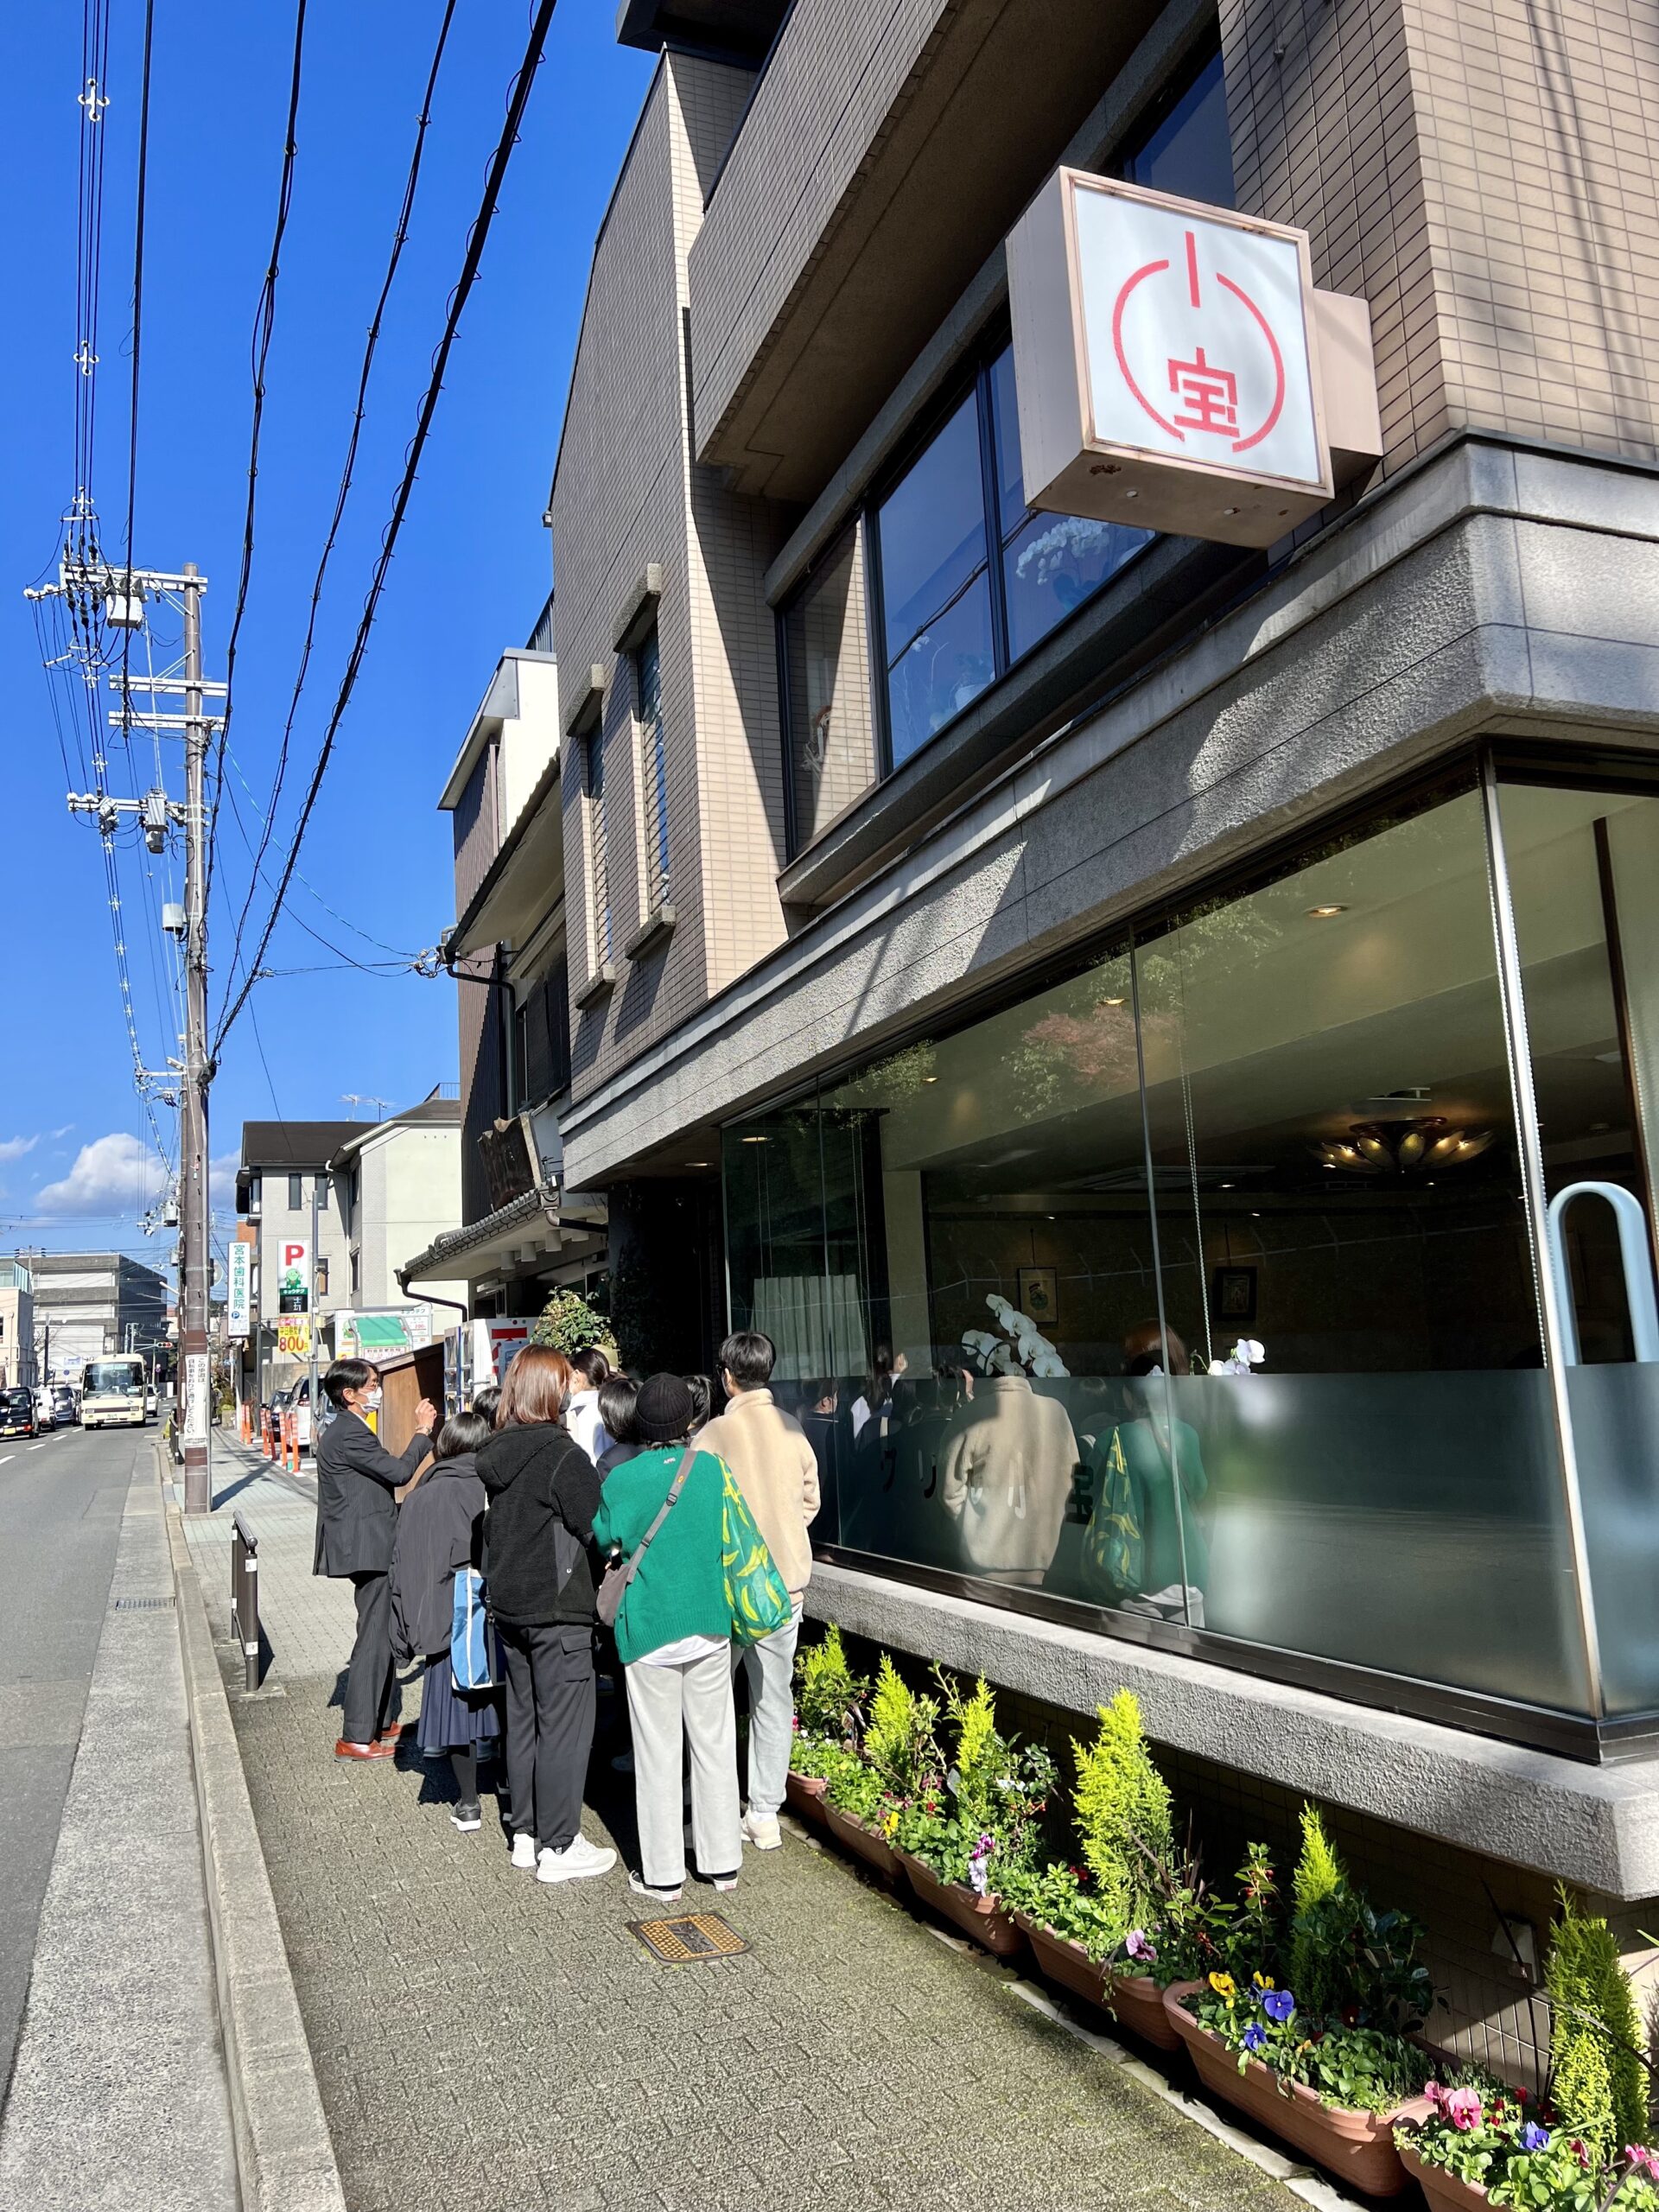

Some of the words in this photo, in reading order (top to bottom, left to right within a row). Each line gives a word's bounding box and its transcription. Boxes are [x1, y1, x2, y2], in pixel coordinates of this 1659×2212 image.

[233, 1244, 245, 1309] 宮本歯科医院
[285, 1244, 304, 1266] P
